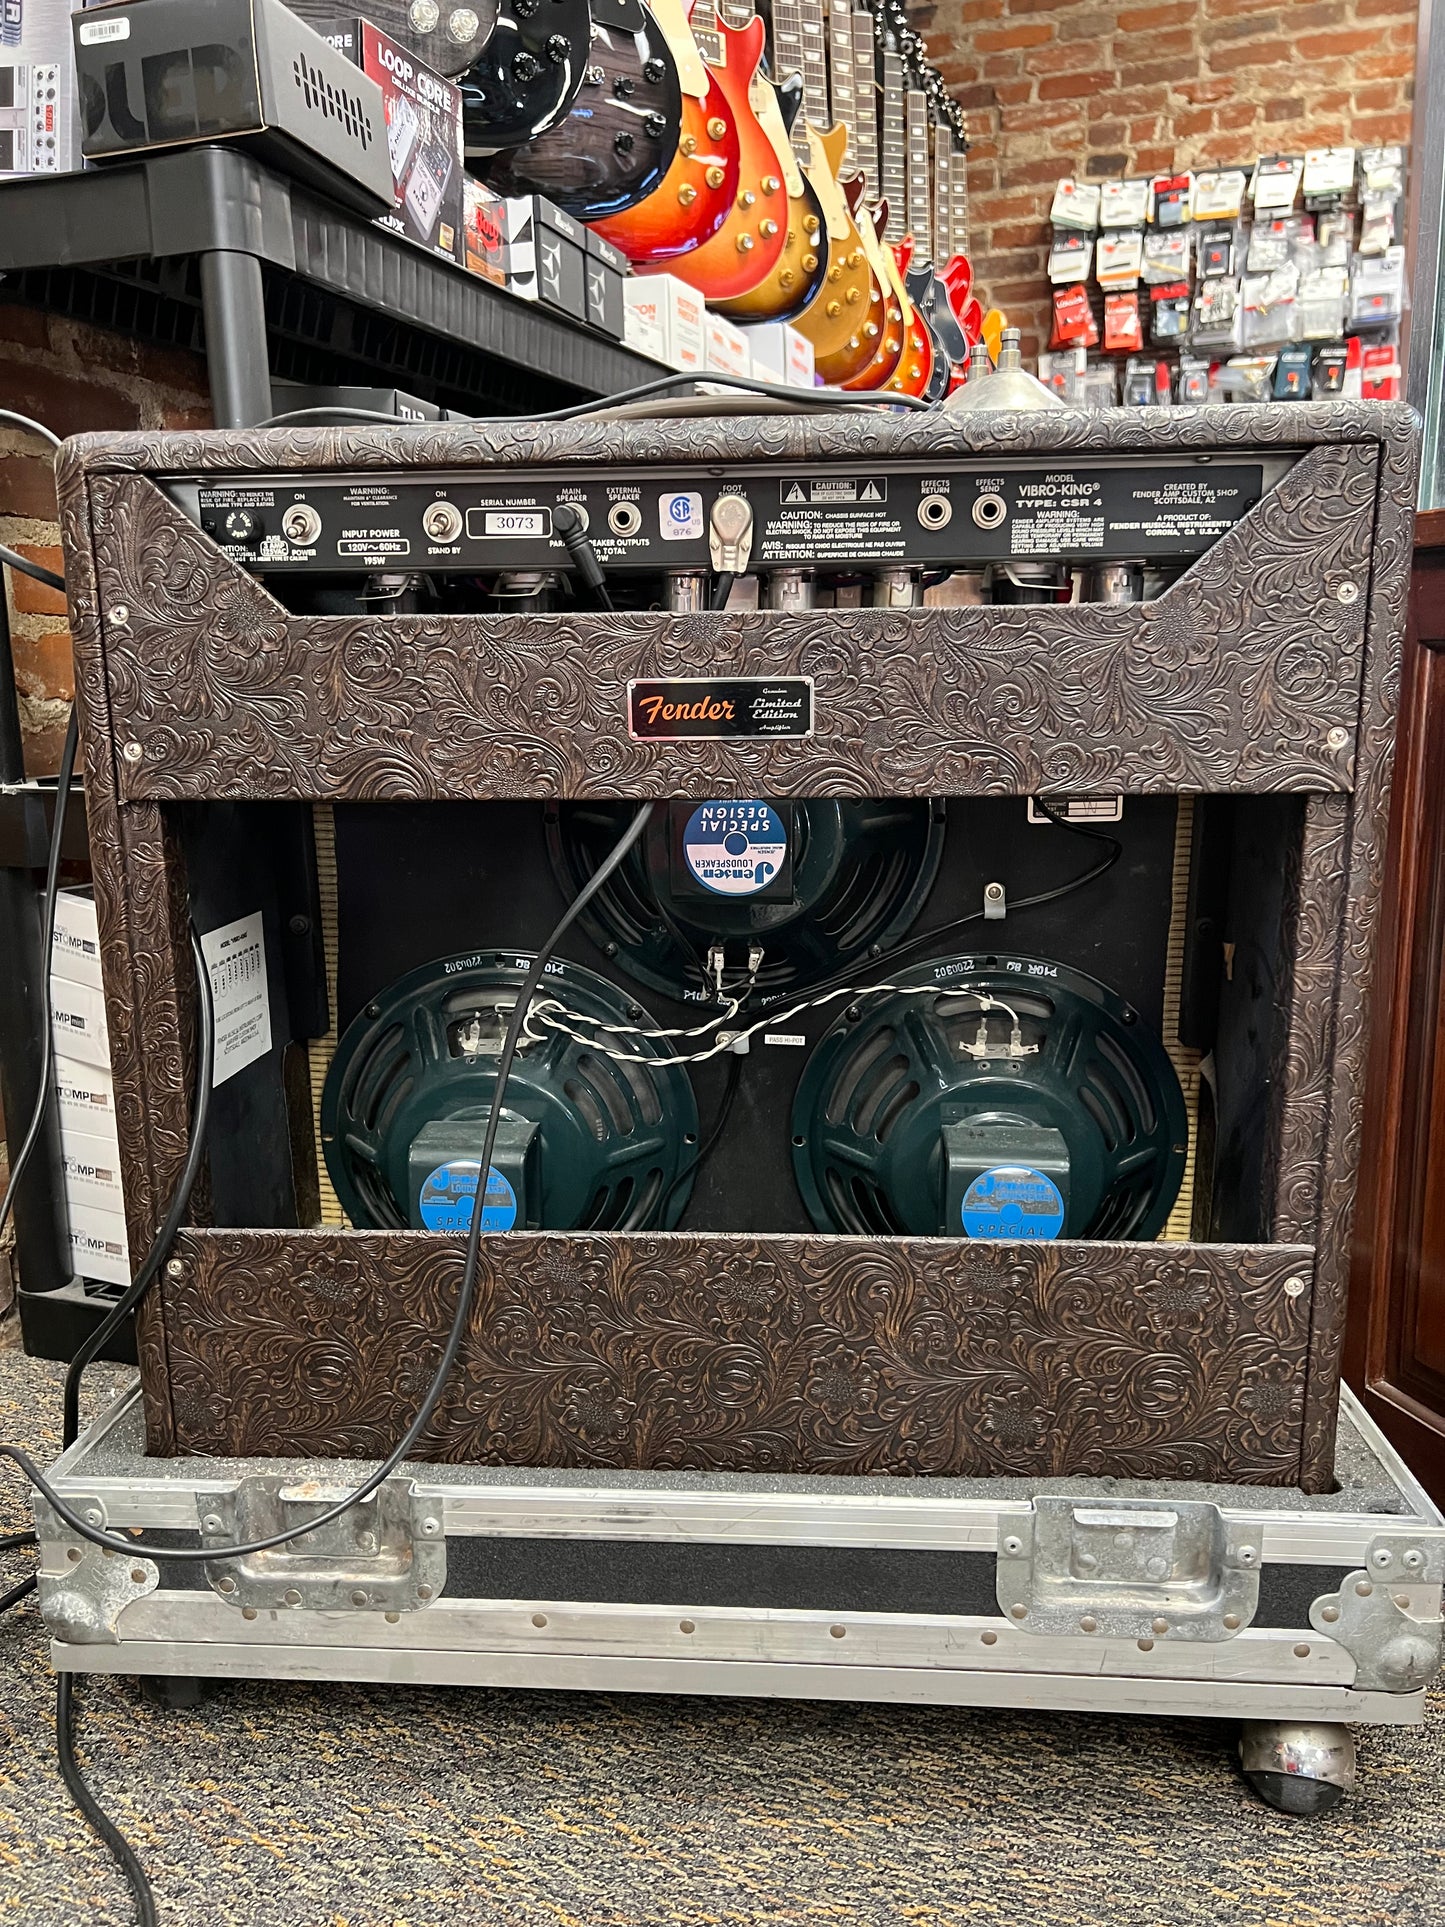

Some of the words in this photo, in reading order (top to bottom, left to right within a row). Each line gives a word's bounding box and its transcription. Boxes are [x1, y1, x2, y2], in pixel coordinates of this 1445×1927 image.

[378, 42, 413, 82] LOOP
[417, 73, 452, 112] CORE
[350, 487, 389, 495] WARNING:
[816, 482, 852, 490] CAUTION:
[200, 490, 238, 498] WARNING:
[1016, 500, 1057, 508] TYPE:
[1061, 499, 1089, 507] CSR
[1154, 497, 1203, 505] SCOTTSDALE,
[240, 513, 251, 527] FUSE
[780, 511, 823, 520] CAUTION:
[1037, 511, 1080, 519] WARNING:
[496, 517, 534, 529] 3073
[767, 521, 812, 529] WARNING:
[1110, 522, 1140, 530] FENDER
[1177, 520, 1230, 528] INSTRUMENTS
[342, 530, 367, 538] INPUT
[370, 529, 400, 537] POWER
[673, 528, 692, 536] 876
[761, 541, 784, 550] AVIS:
[763, 550, 815, 559] ATTENTION:
[749, 698, 802, 708] Limited
[638, 695, 736, 724] Fender
[752, 709, 799, 719] Edition
[702, 807, 767, 819] DESIGN
[700, 819, 770, 832] SPECIAL
[695, 859, 753, 869] LOUDSPEAKER
[702, 861, 775, 884] Jensen
[53, 931, 82, 948] STOMP
[544, 963, 564, 974] P10
[934, 960, 975, 978] 2200302
[1028, 964, 1057, 977] P10R
[437, 1217, 500, 1226] SPECAL
[978, 1224, 1045, 1235] SPECIAL
